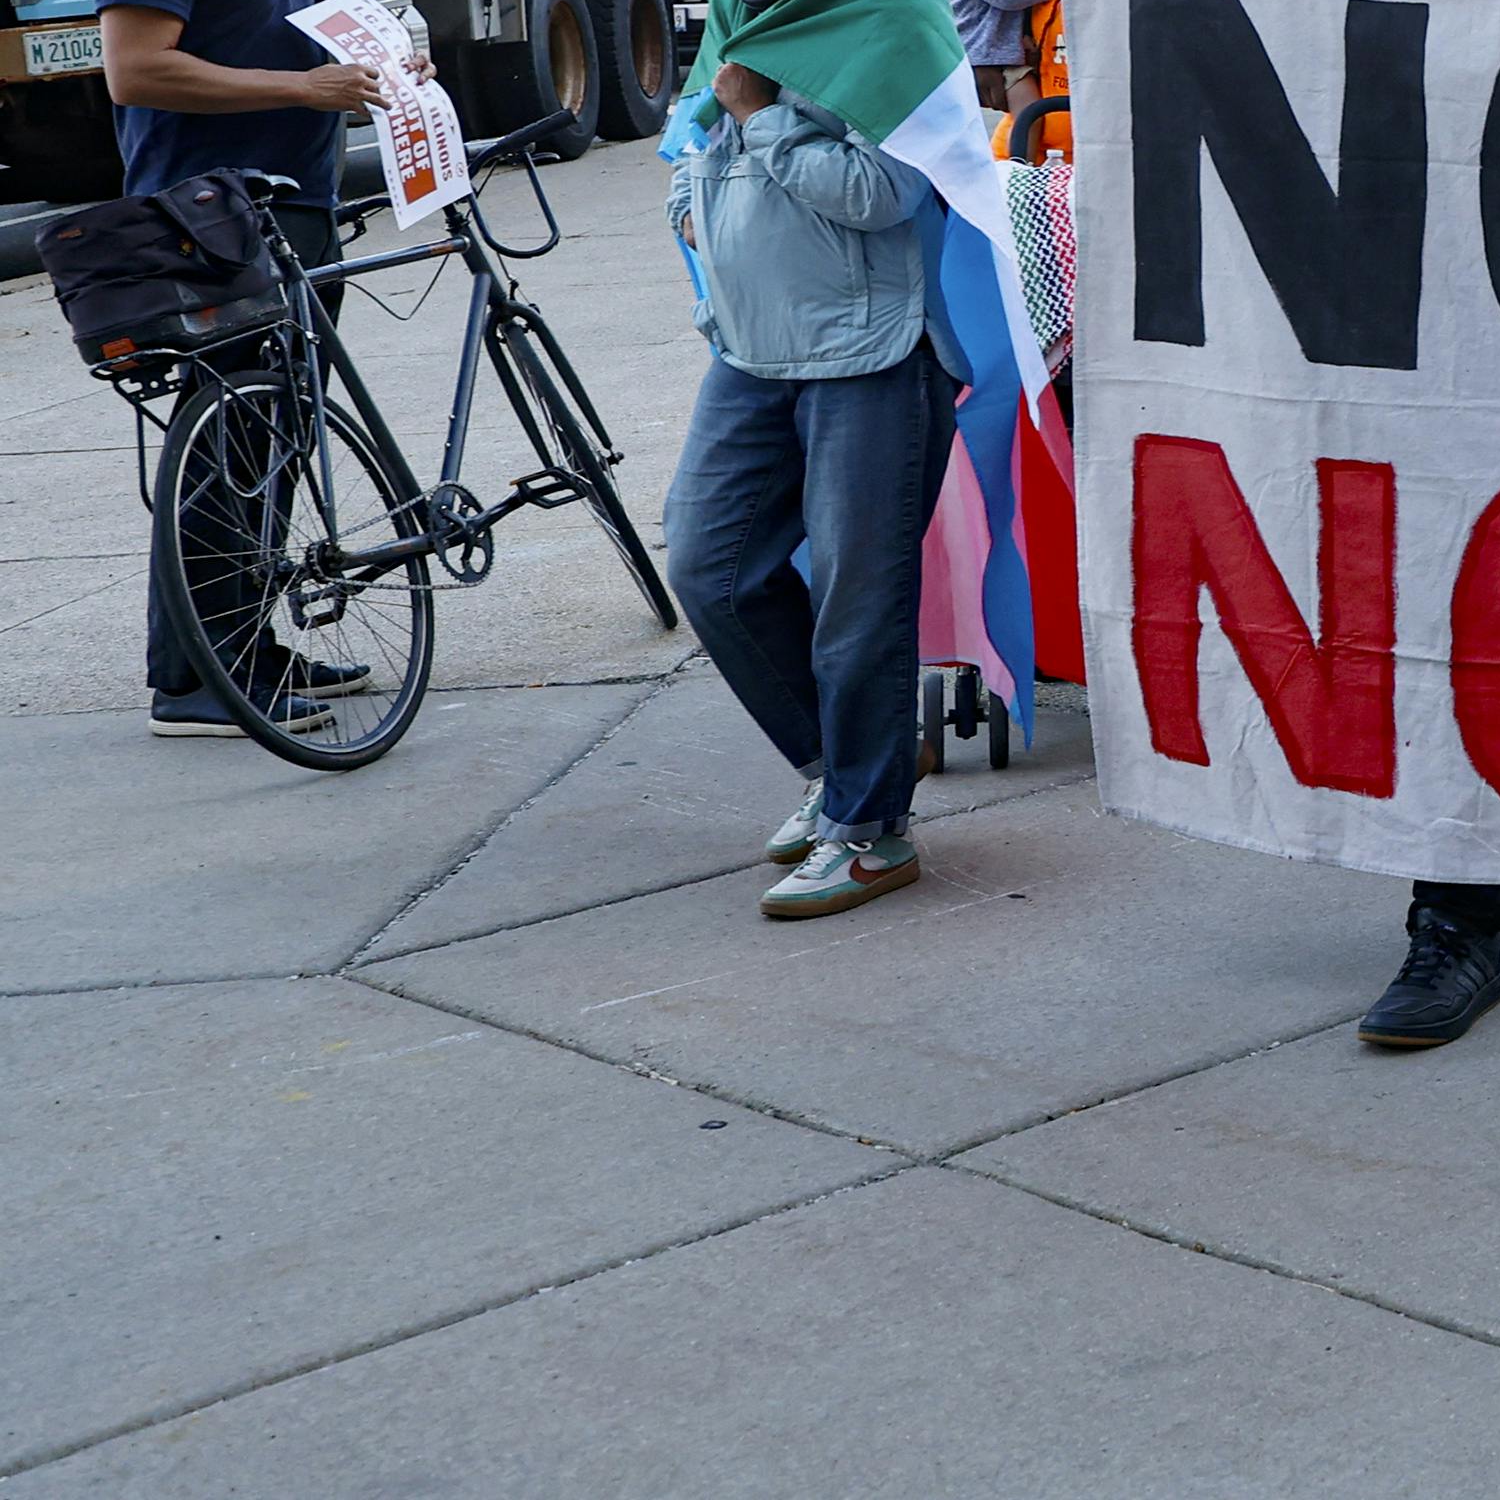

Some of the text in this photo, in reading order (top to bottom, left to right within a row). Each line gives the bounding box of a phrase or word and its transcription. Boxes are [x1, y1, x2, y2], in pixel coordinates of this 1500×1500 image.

[31, 43, 45, 64] M
[397, 85, 425, 132] OUT
[413, 140, 432, 170] OF
[430, 106, 453, 181] ILLINOIS
